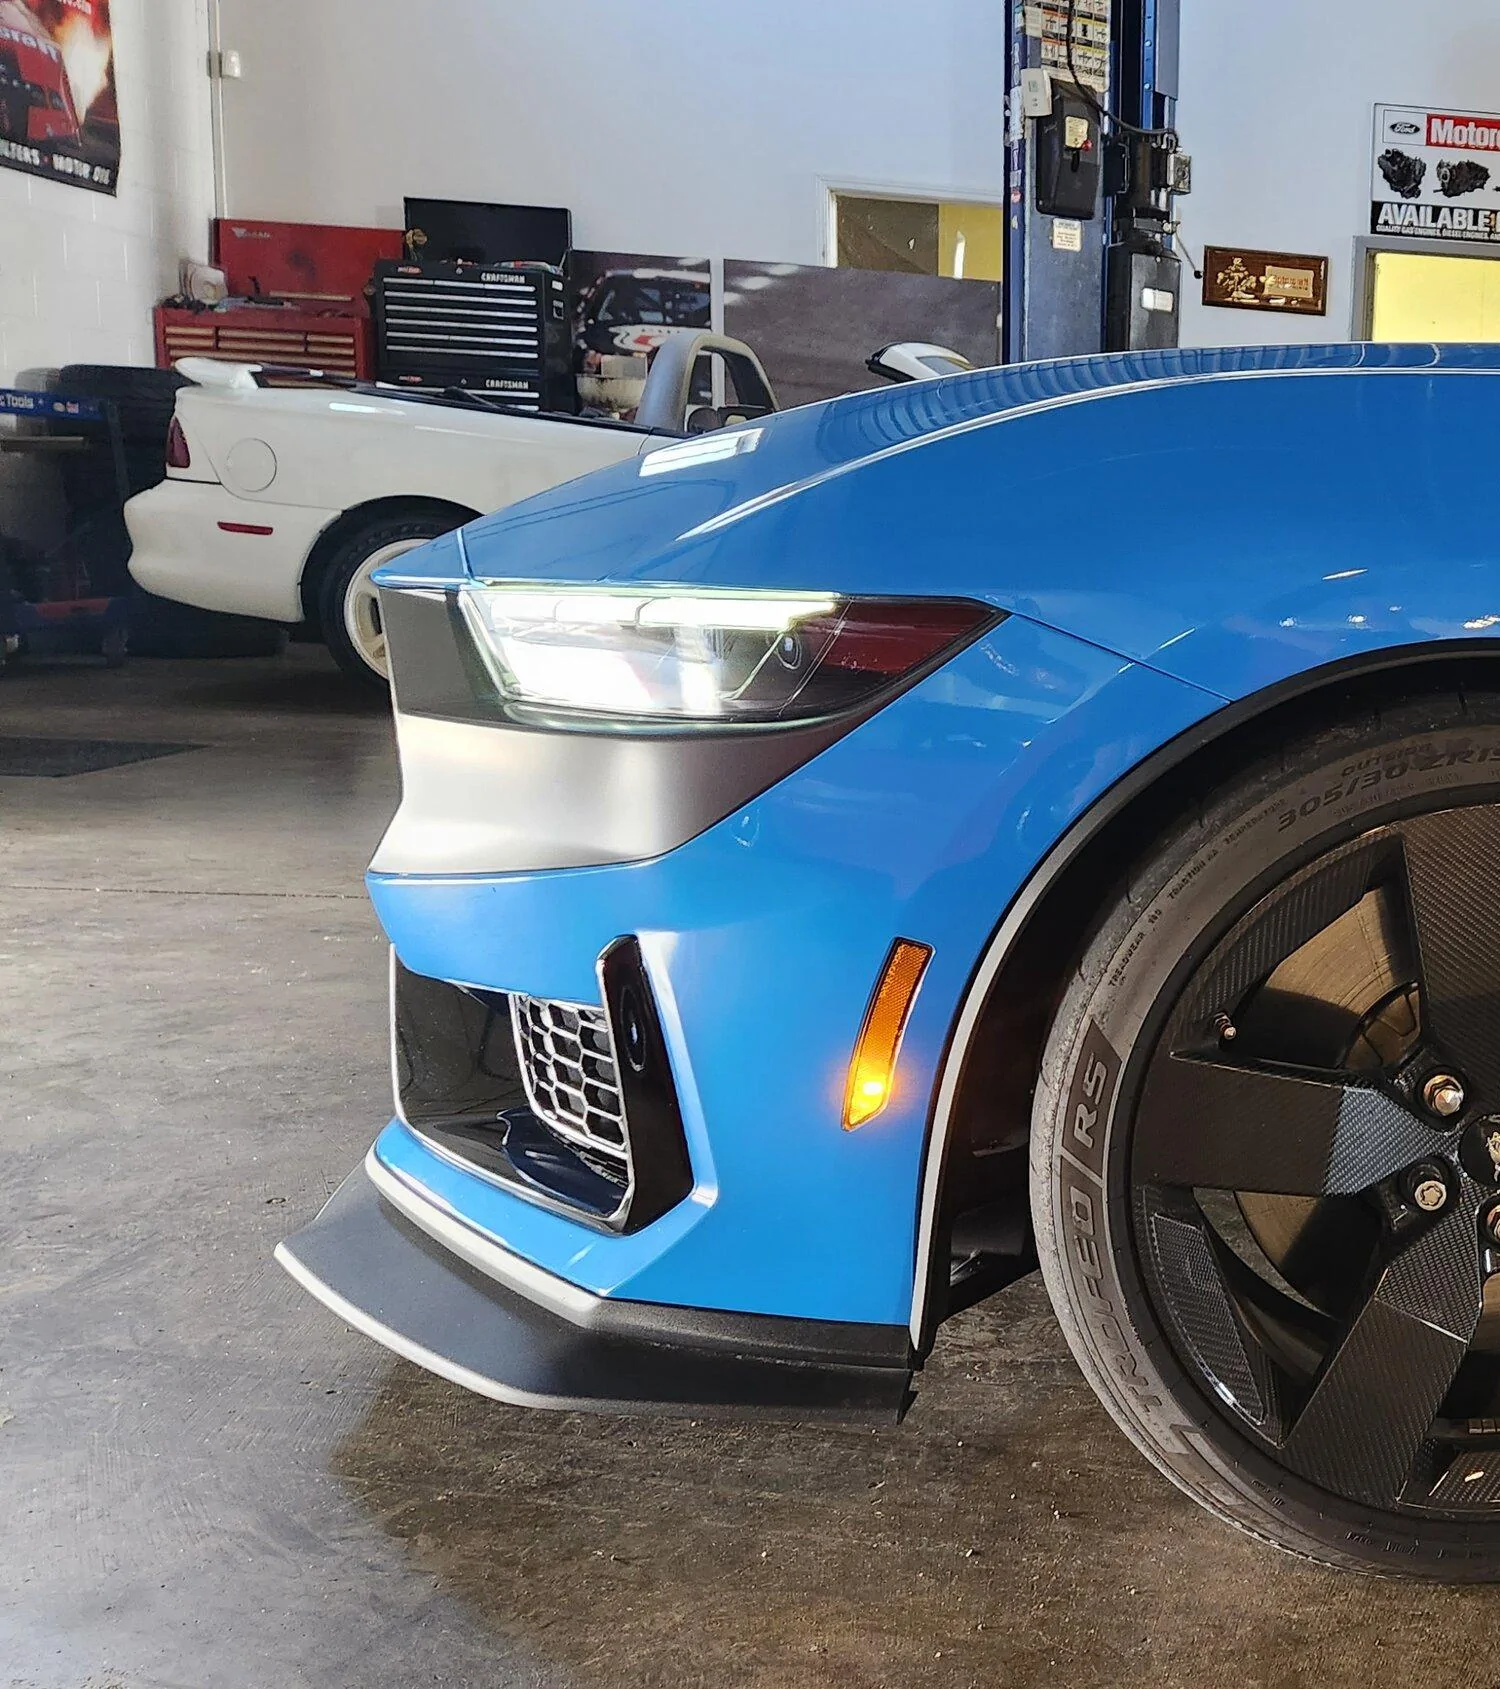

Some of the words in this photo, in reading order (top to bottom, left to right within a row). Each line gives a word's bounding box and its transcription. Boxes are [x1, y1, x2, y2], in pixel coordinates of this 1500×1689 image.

[1393, 122, 1417, 134] Ford
[1377, 202, 1491, 232] AVAILABLE
[480, 272, 525, 284] CRAFTSMAN
[485, 378, 529, 390] CRAFTSMAN
[6, 393, 34, 409] Tools
[1277, 756, 1408, 833] 305/30
[1072, 1051, 1109, 1149] RS
[1071, 1184, 1163, 1415] TROFEO
